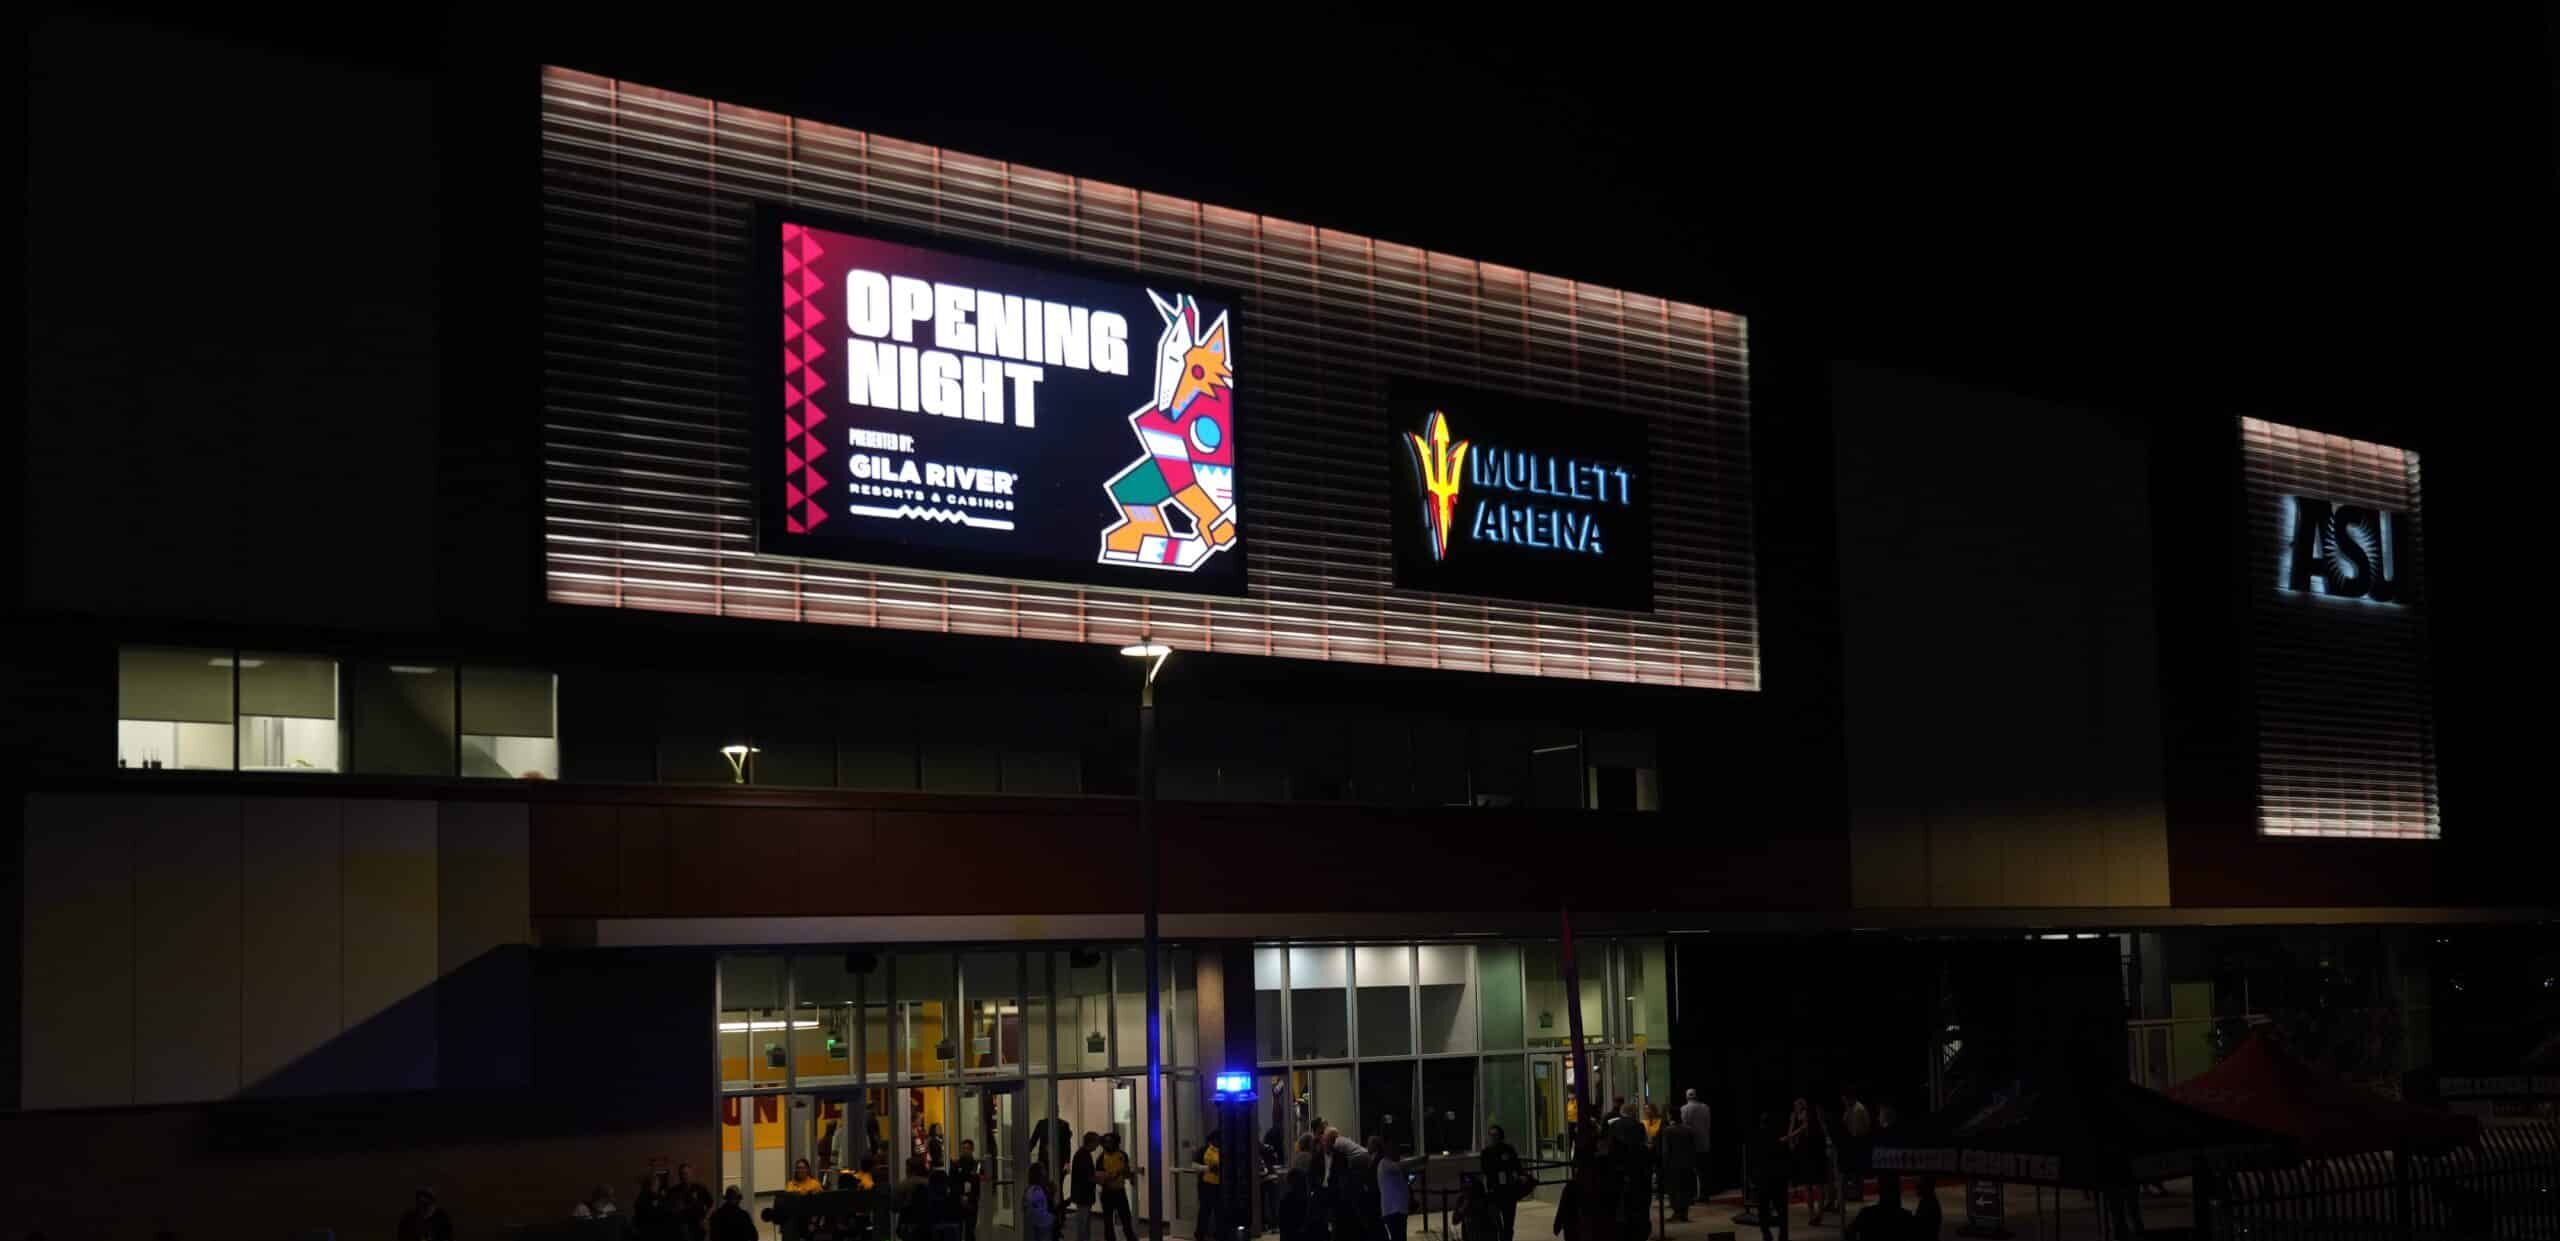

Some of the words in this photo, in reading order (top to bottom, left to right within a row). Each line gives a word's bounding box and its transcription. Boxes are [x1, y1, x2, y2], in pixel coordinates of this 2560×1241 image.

[847, 269, 1129, 376] OPENING
[848, 338, 1044, 428] NIGHT
[849, 428, 898, 450] PRESENTED
[849, 454, 922, 484] GILA
[849, 483, 925, 501] RESORTS
[931, 492, 941, 503] &
[946, 494, 1014, 511] CASINOS
[1472, 446, 1632, 505] MULLETT
[1472, 501, 1604, 555] ARENA
[2287, 496, 2408, 605] ASU
